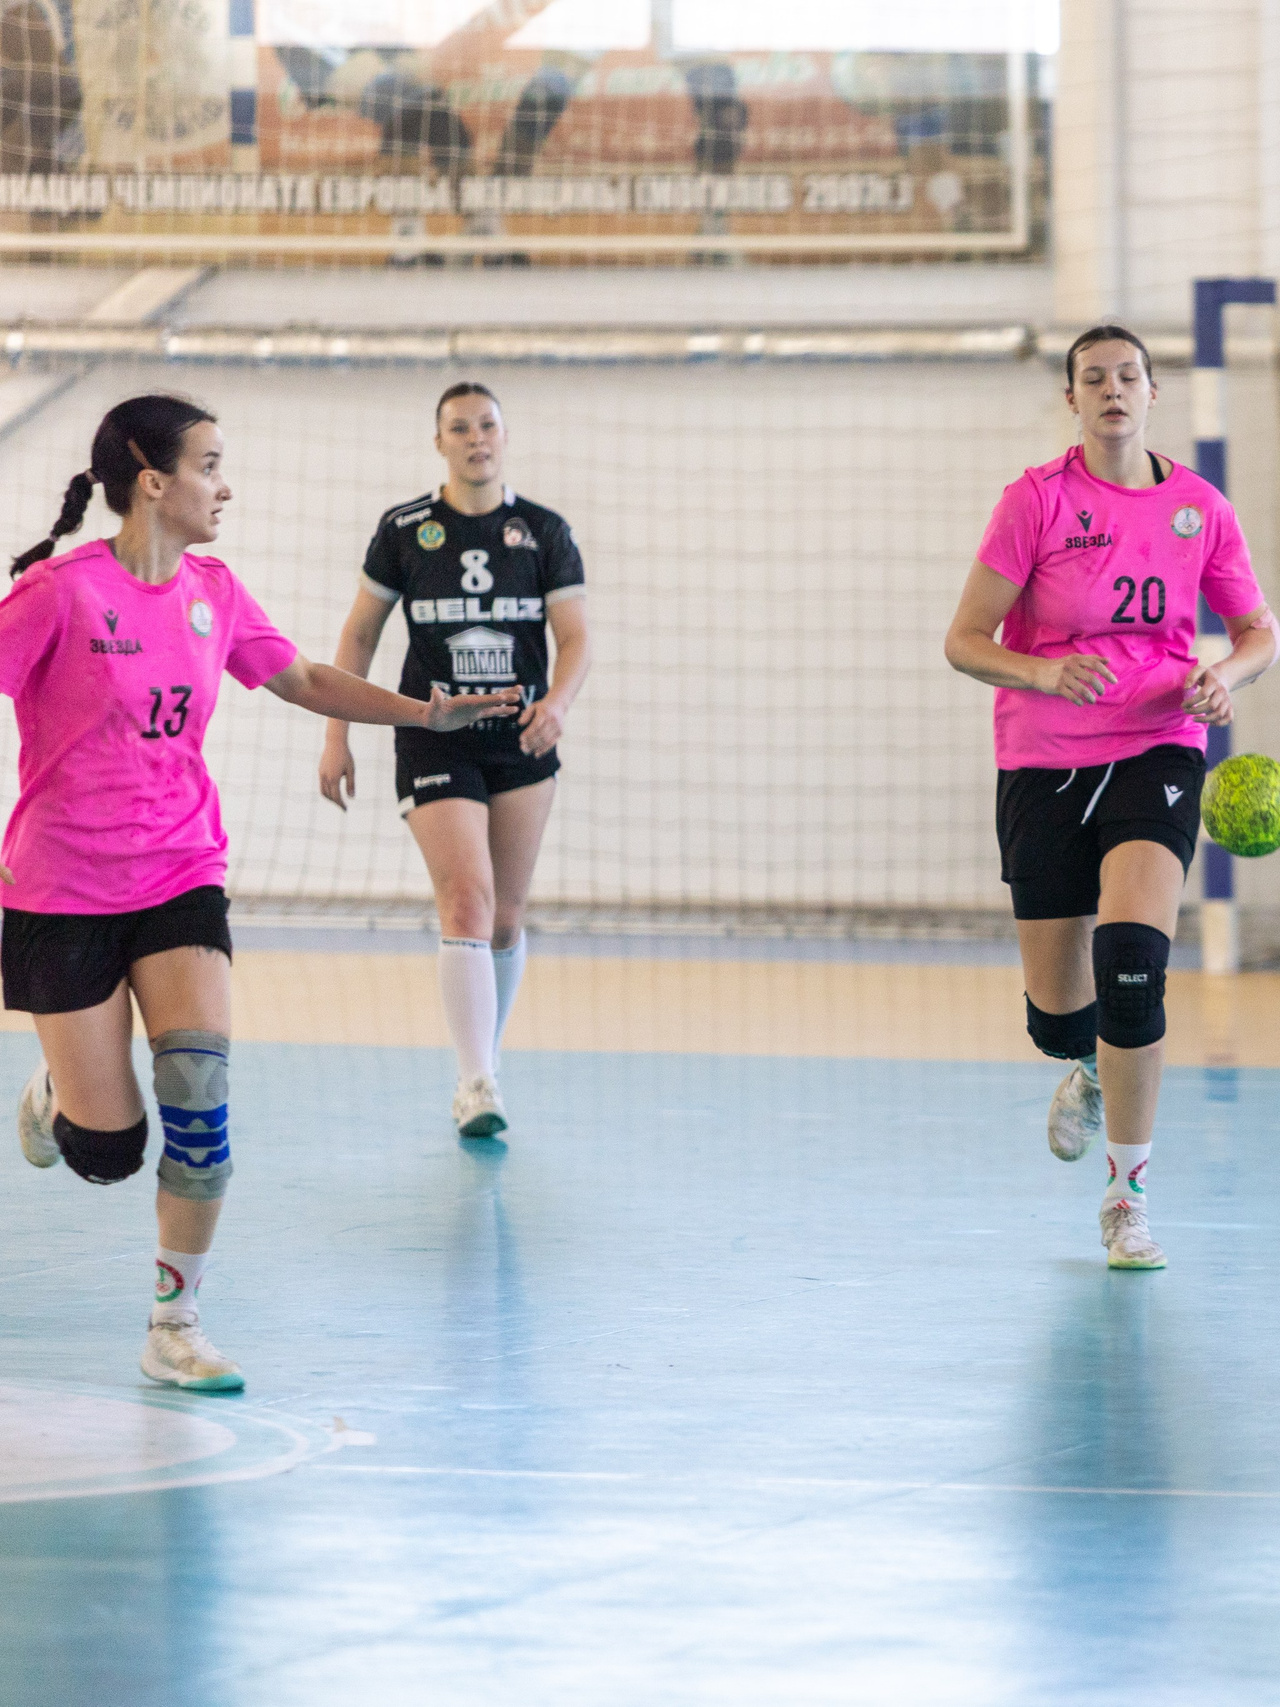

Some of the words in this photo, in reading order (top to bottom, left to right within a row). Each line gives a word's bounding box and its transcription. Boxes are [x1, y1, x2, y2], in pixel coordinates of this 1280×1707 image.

[113, 174, 317, 212] ЧЕМПИОНАТА
[1065, 533, 1113, 549] ЗВЕЗДА
[460, 549, 494, 594] 8
[411, 597, 543, 624] BELAZ
[1110, 575, 1166, 624] 20
[90, 638, 143, 655] ЗВЕЗДА
[140, 685, 193, 739] 13
[1117, 973, 1148, 983] SELECT
